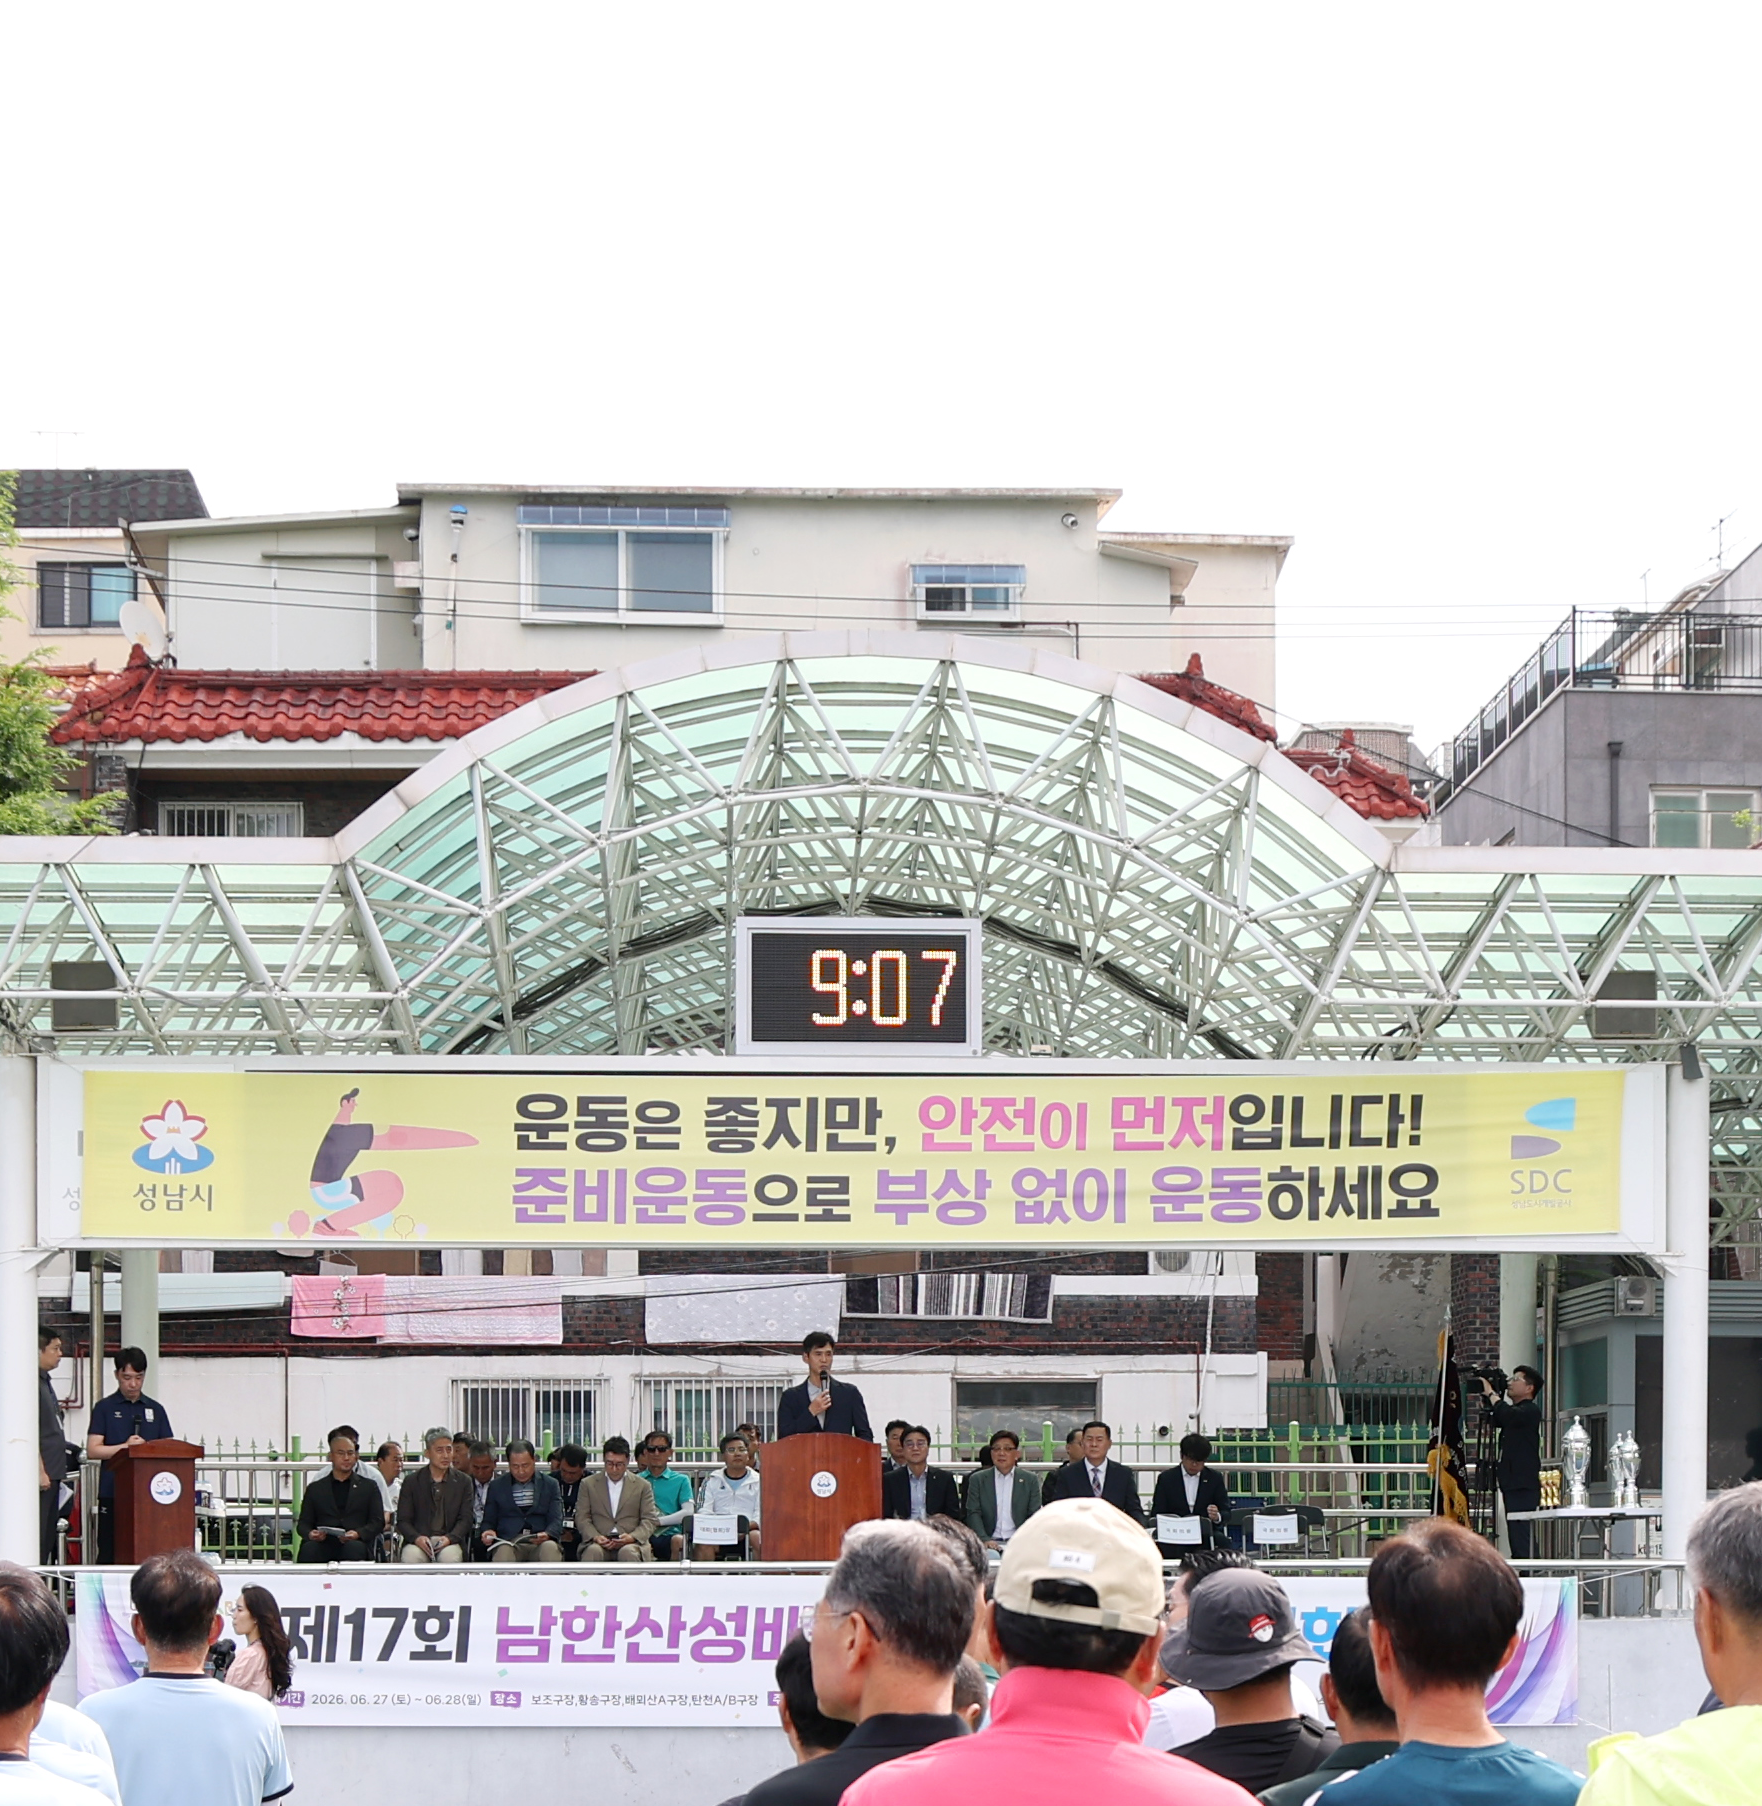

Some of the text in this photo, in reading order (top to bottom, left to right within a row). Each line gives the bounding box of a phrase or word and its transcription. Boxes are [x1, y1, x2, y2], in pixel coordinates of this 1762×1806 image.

[811, 949, 957, 1027] 9:07
[514, 1092, 1423, 1155] 운동은 좋지만, 안전이 먼저입니다!
[134, 1183, 213, 1212] 성남시
[512, 1163, 1440, 1228] 준비운동으로 부상 없이 운동하세요
[1511, 1169, 1572, 1195] SDC
[284, 1604, 471, 1663] 제17회
[311, 1694, 347, 1705] 2026.
[350, 1694, 370, 1705] 06.
[373, 1694, 388, 1705] 27
[391, 1694, 412, 1706] (토)
[425, 1694, 482, 1706] 06.28(일)
[494, 1693, 517, 1704] 장소
